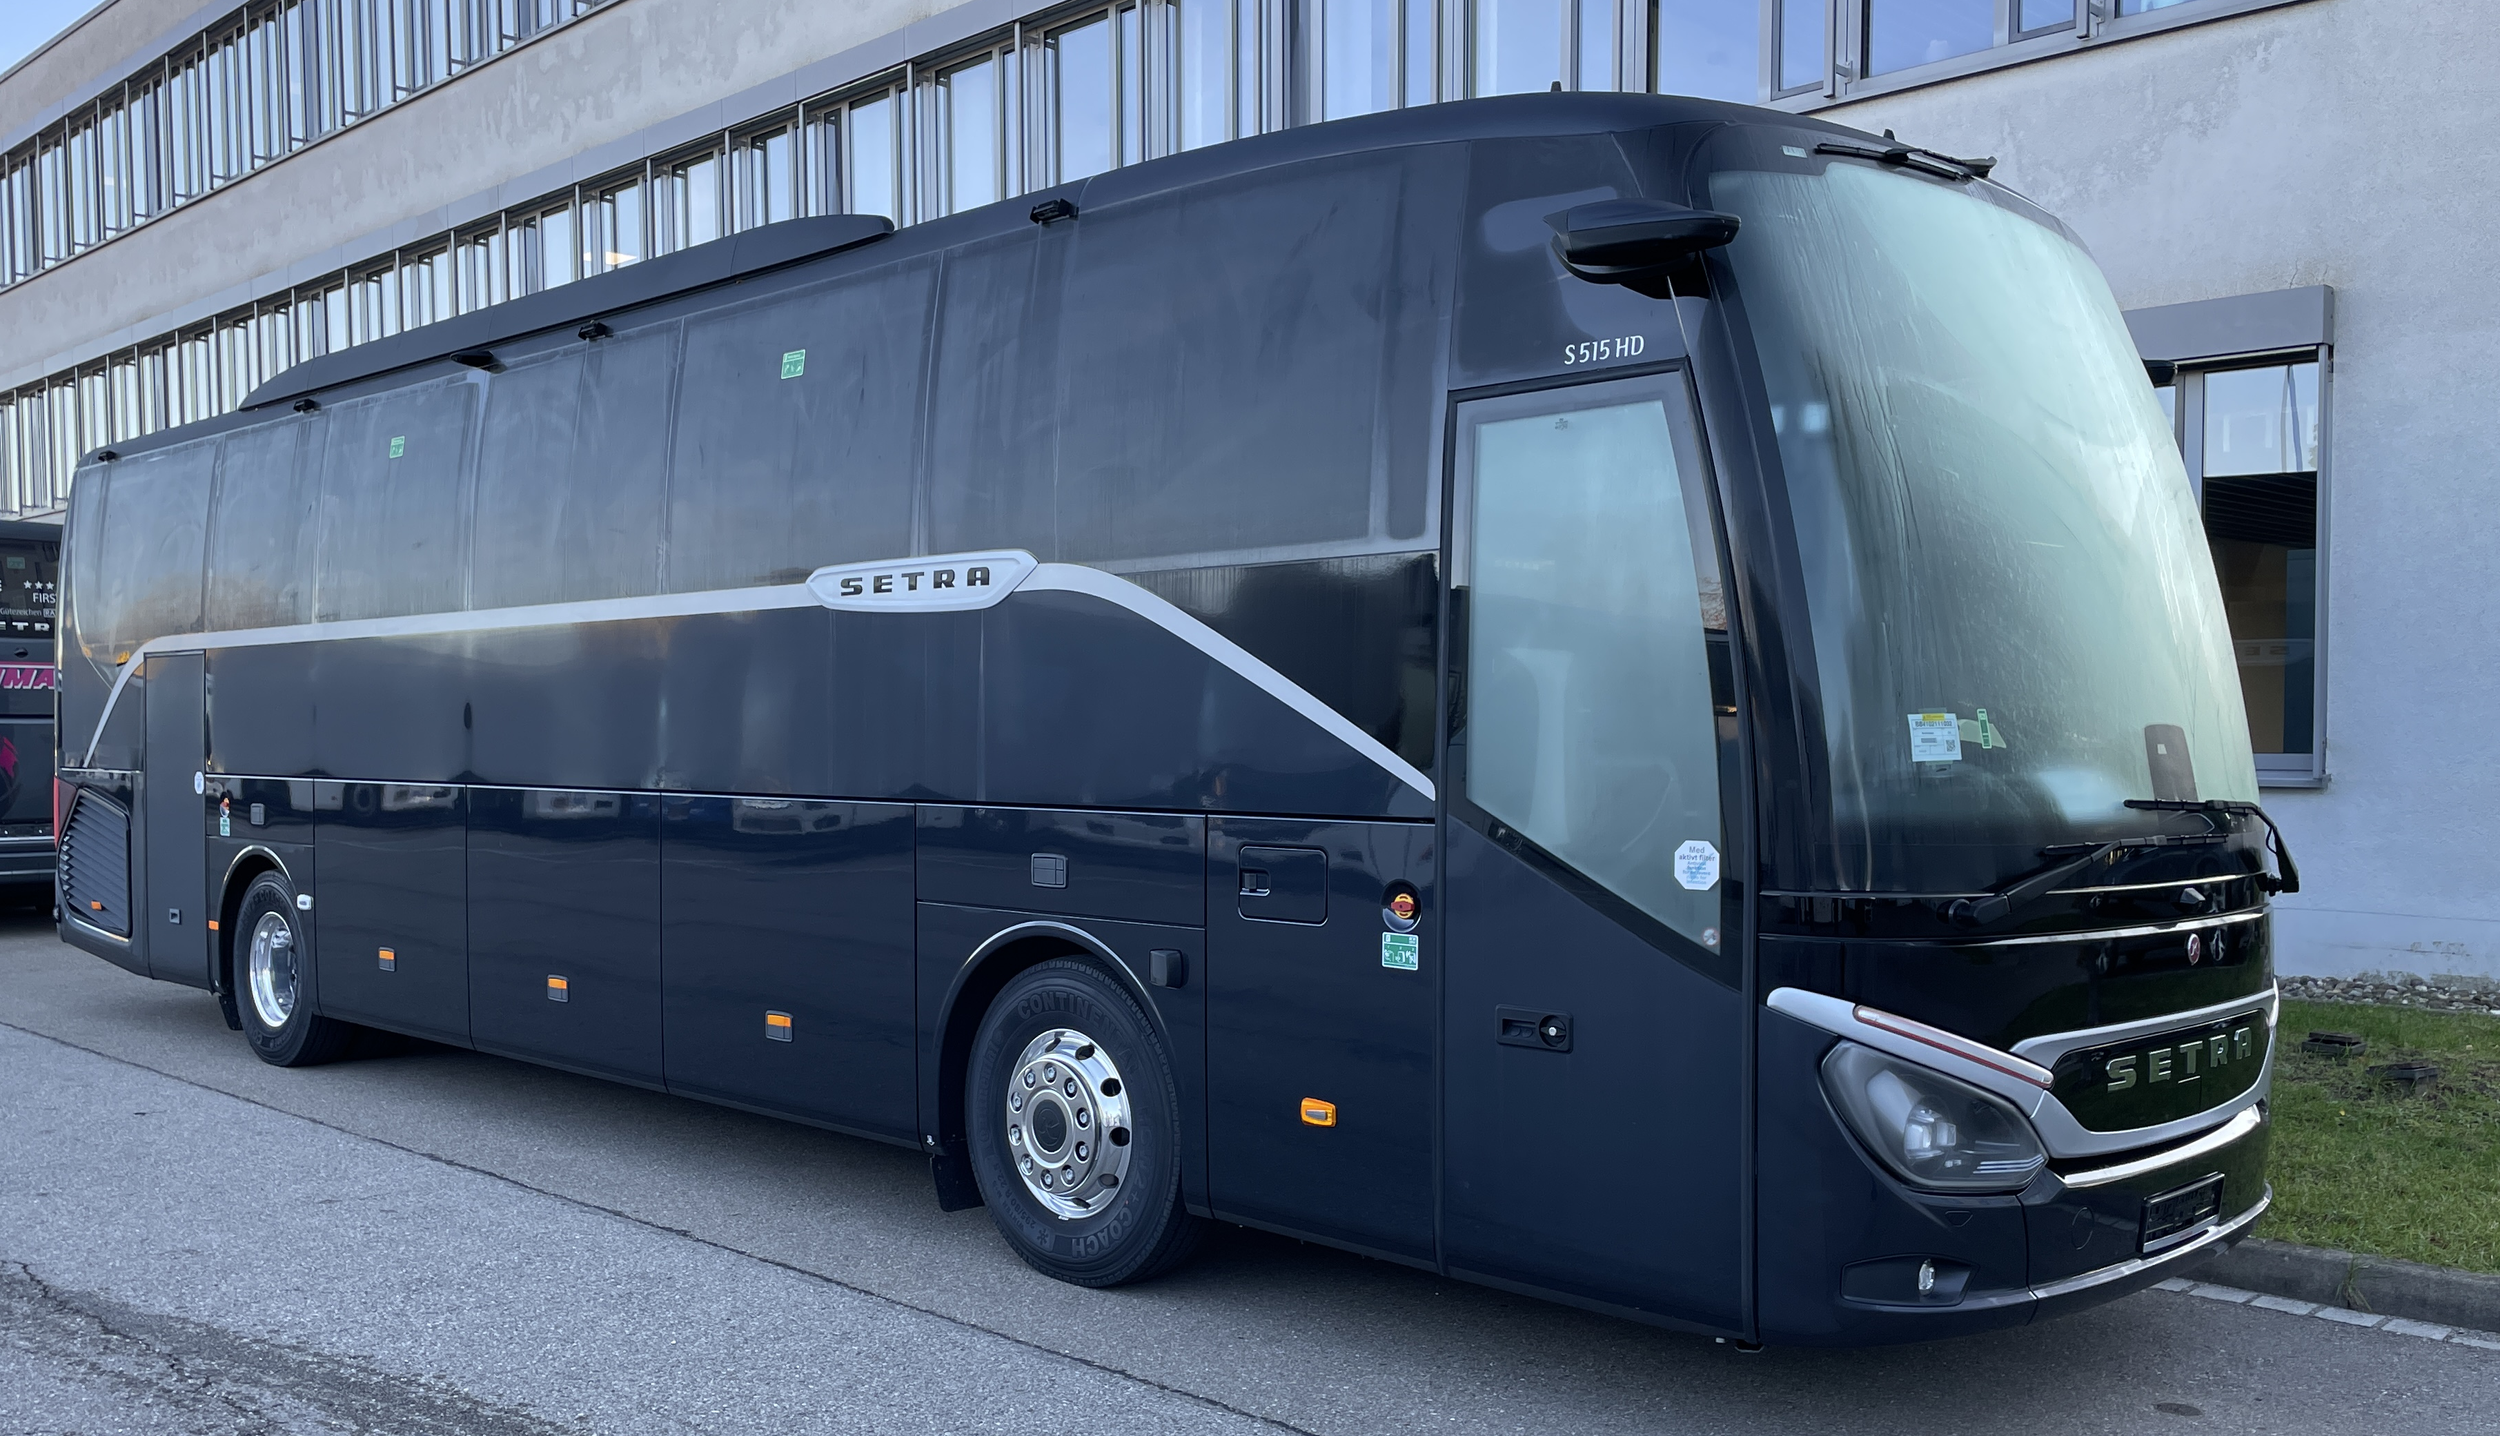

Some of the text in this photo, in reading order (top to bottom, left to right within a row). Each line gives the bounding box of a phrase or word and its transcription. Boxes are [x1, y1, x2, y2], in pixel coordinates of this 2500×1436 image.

[1564, 335, 1645, 365] S 515 HD
[32, 592, 57, 604] FIRS
[840, 566, 990, 596] SETRA
[1018, 992, 1139, 1078] CONTINENTAL
[2105, 1026, 2252, 1092] SETRA
[1071, 1207, 1134, 1259] COACH
